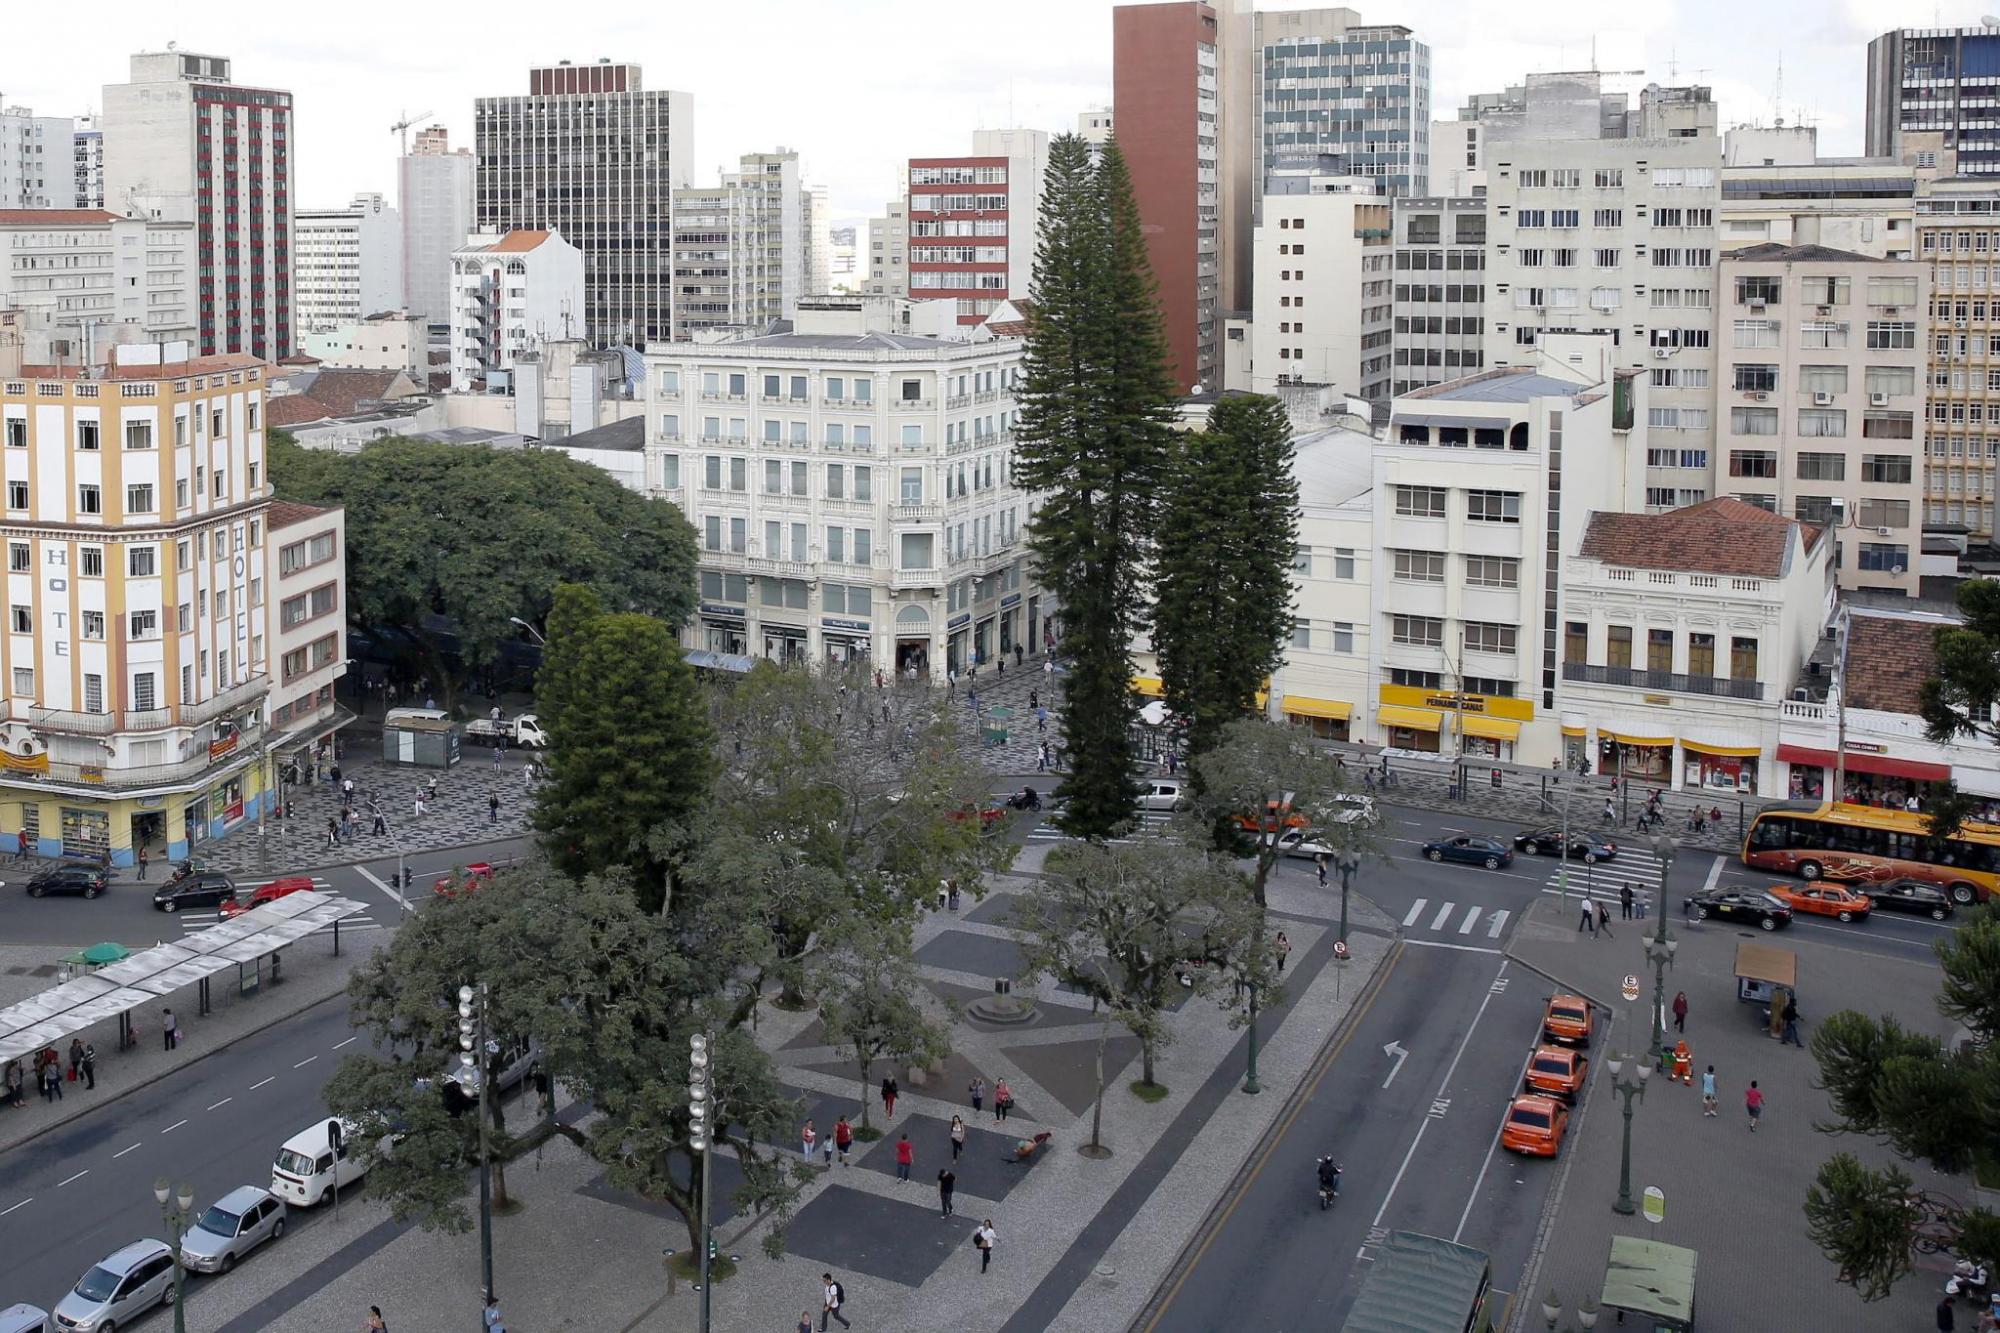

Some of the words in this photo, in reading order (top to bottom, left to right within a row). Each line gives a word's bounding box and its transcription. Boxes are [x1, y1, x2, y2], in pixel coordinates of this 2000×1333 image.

[47, 549, 69, 657] HOTE
[233, 526, 247, 668] HOTEL
[1426, 698, 1484, 712] PERNAMBCANAS
[1427, 1097, 1451, 1119] TAXI
